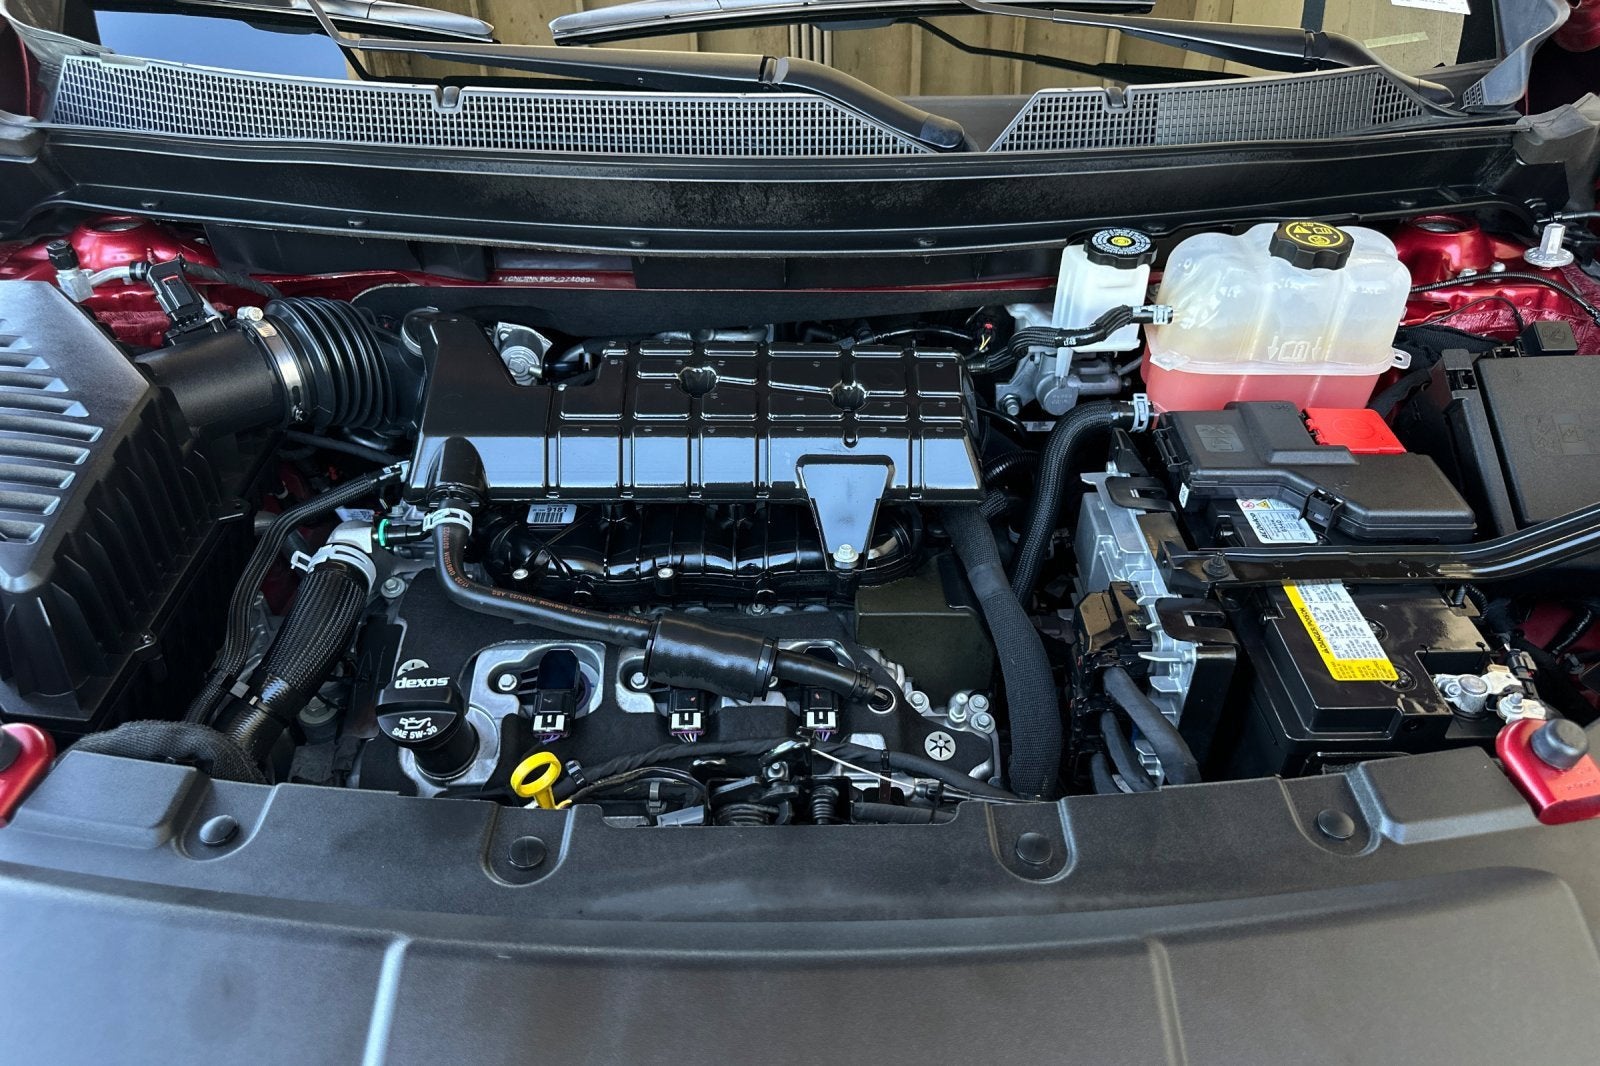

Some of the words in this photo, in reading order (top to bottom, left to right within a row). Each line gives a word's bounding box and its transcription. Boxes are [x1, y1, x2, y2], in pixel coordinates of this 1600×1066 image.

[394, 676, 450, 689] dexos
[391, 727, 408, 739] SAE
[409, 725, 438, 740] 5W-30
